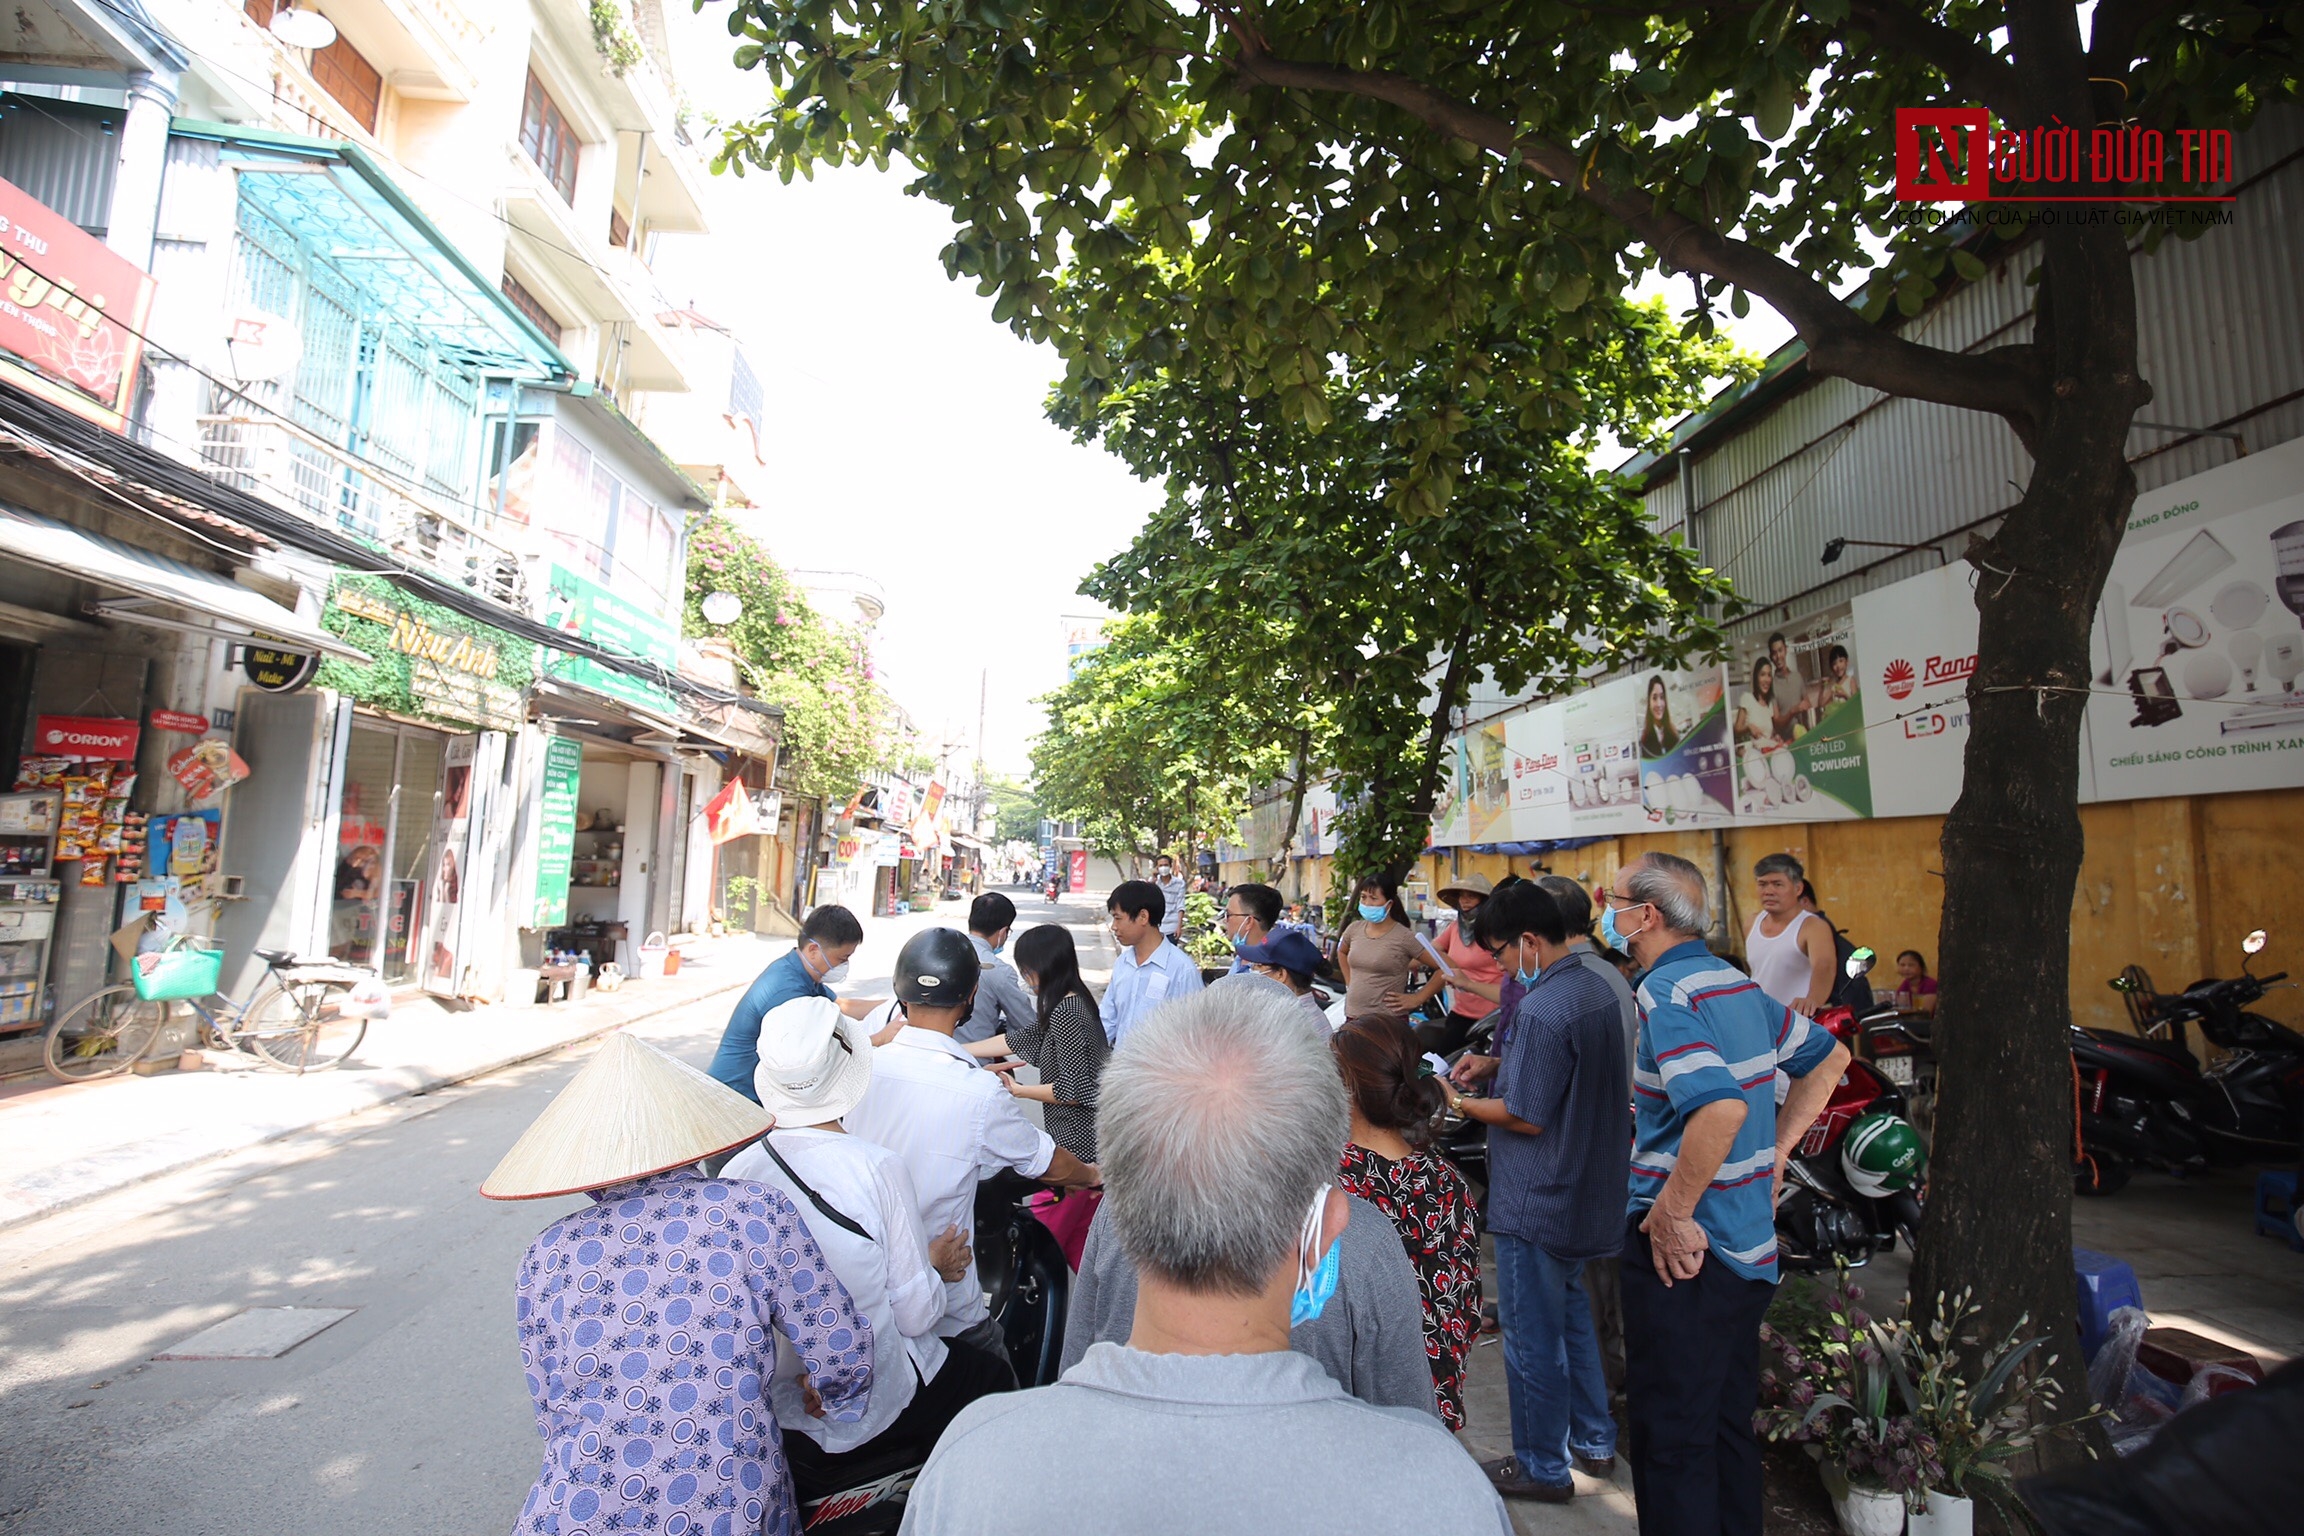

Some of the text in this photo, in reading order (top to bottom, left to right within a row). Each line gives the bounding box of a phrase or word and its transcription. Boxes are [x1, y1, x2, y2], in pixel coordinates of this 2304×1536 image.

[14, 225, 49, 256] THU
[447, 635, 500, 680] Anh
[1904, 714, 1946, 739] LED
[67, 735, 123, 748] ORION
[1829, 740, 1846, 753] LED
[2147, 748, 2182, 765] SÁNG
[2185, 745, 2227, 760] CÔNG
[2231, 740, 2272, 756] TRÌNH
[1811, 755, 1861, 773] DOWLIGHT
[1892, 1147, 1915, 1168] Grab
